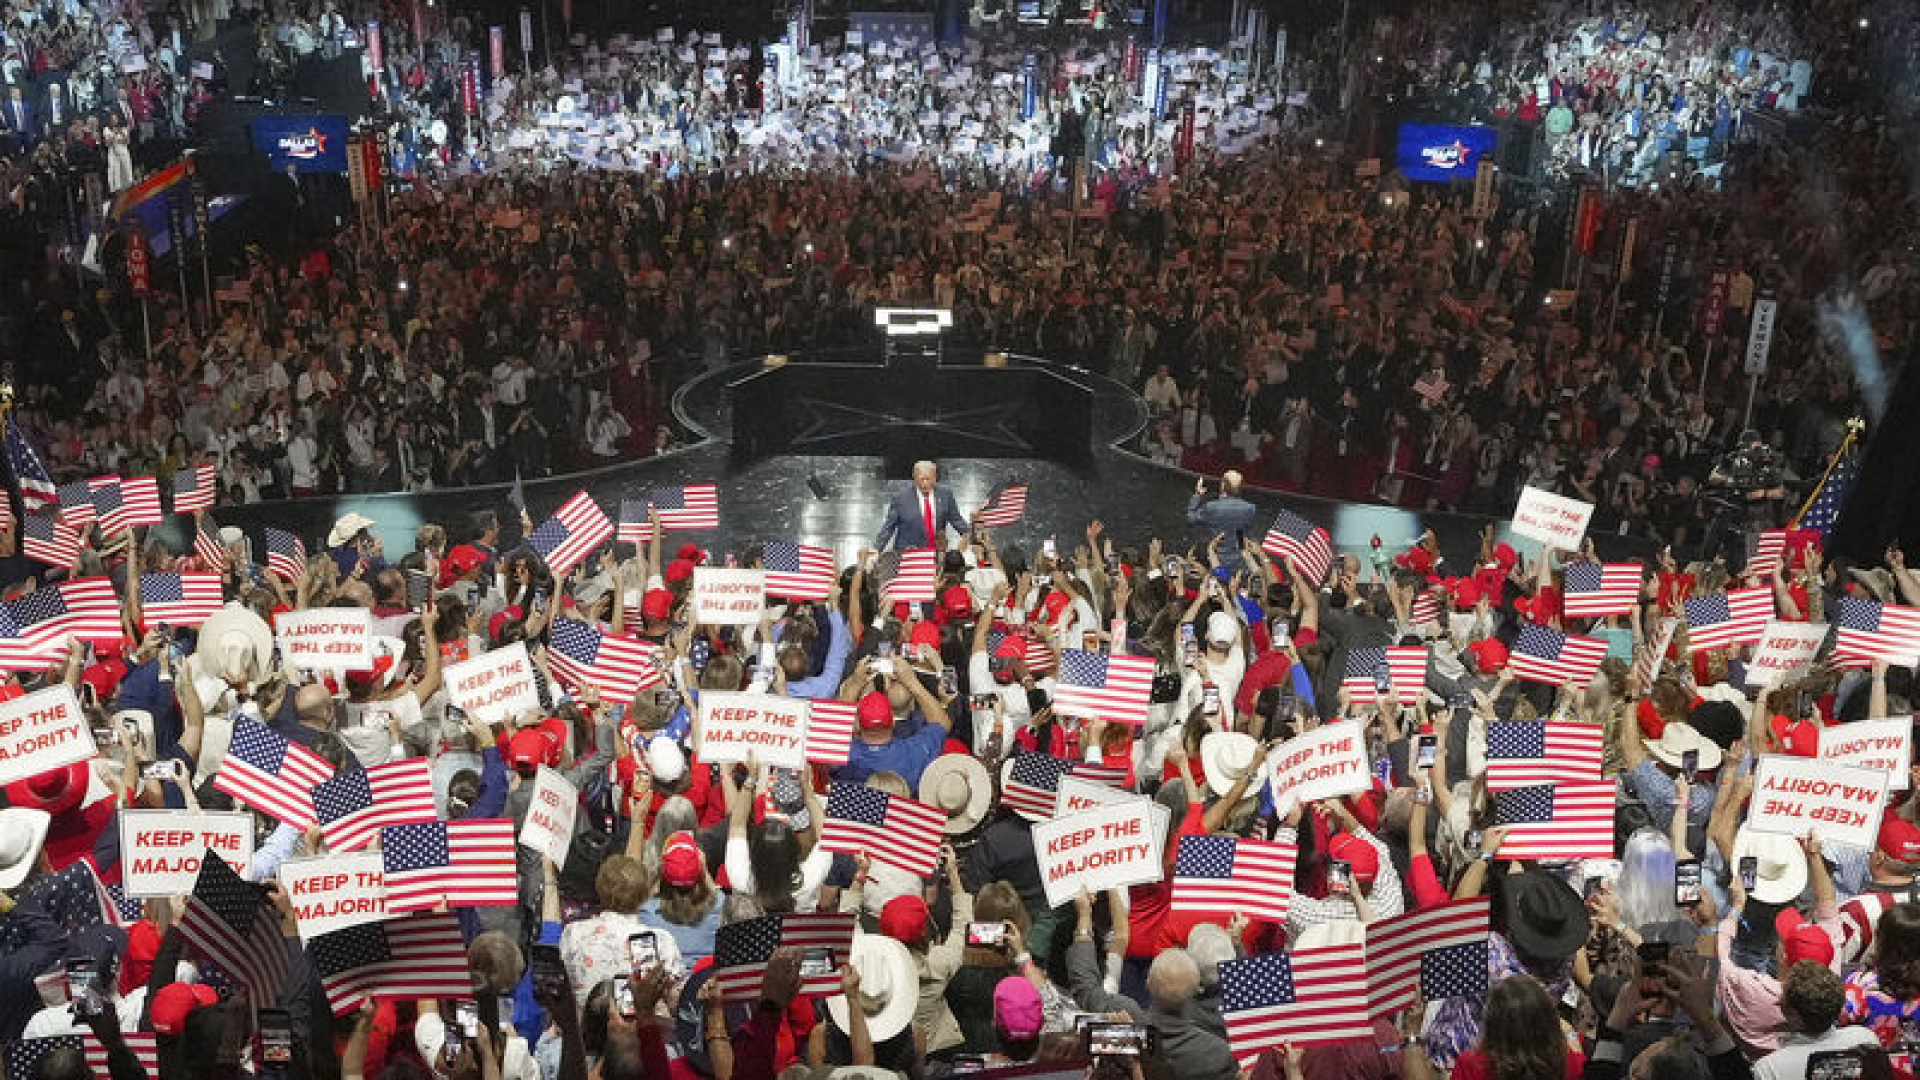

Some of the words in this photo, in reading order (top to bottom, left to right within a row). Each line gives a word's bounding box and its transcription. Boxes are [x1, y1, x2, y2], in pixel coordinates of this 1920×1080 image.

[131, 234, 145, 289] IOWA
[1705, 272, 1727, 334] MAINE
[1752, 303, 1770, 369] VERMONT
[283, 623, 366, 637] MAJORITY
[289, 641, 320, 654] THE
[323, 642, 363, 654] KEEP
[457, 669, 495, 692] KEEP
[498, 659, 524, 677] THE
[460, 679, 530, 711] MAJORITY
[28, 703, 68, 726] THE
[709, 707, 759, 721] KEEP
[762, 710, 798, 728] THE
[0, 723, 80, 760] AJORITY
[704, 729, 800, 749] MAJORITY
[1823, 736, 1904, 759] MAJORITY
[1275, 748, 1314, 776] KEEP
[1317, 737, 1354, 757] THE
[1276, 757, 1362, 797] MAJORITY
[1761, 775, 1880, 805] MAJORITY
[1761, 799, 1804, 817] THE
[1808, 806, 1869, 828] KEEP
[136, 829, 195, 848] KEEP
[201, 830, 242, 850] THE
[1047, 828, 1096, 858] KEEP
[1101, 818, 1142, 840] THE
[132, 857, 246, 875] MAJOY
[1047, 843, 1150, 884] MAJORITY
[292, 873, 349, 896] KEEP
[354, 870, 385, 888] TH
[292, 897, 386, 920] MAJORIT
